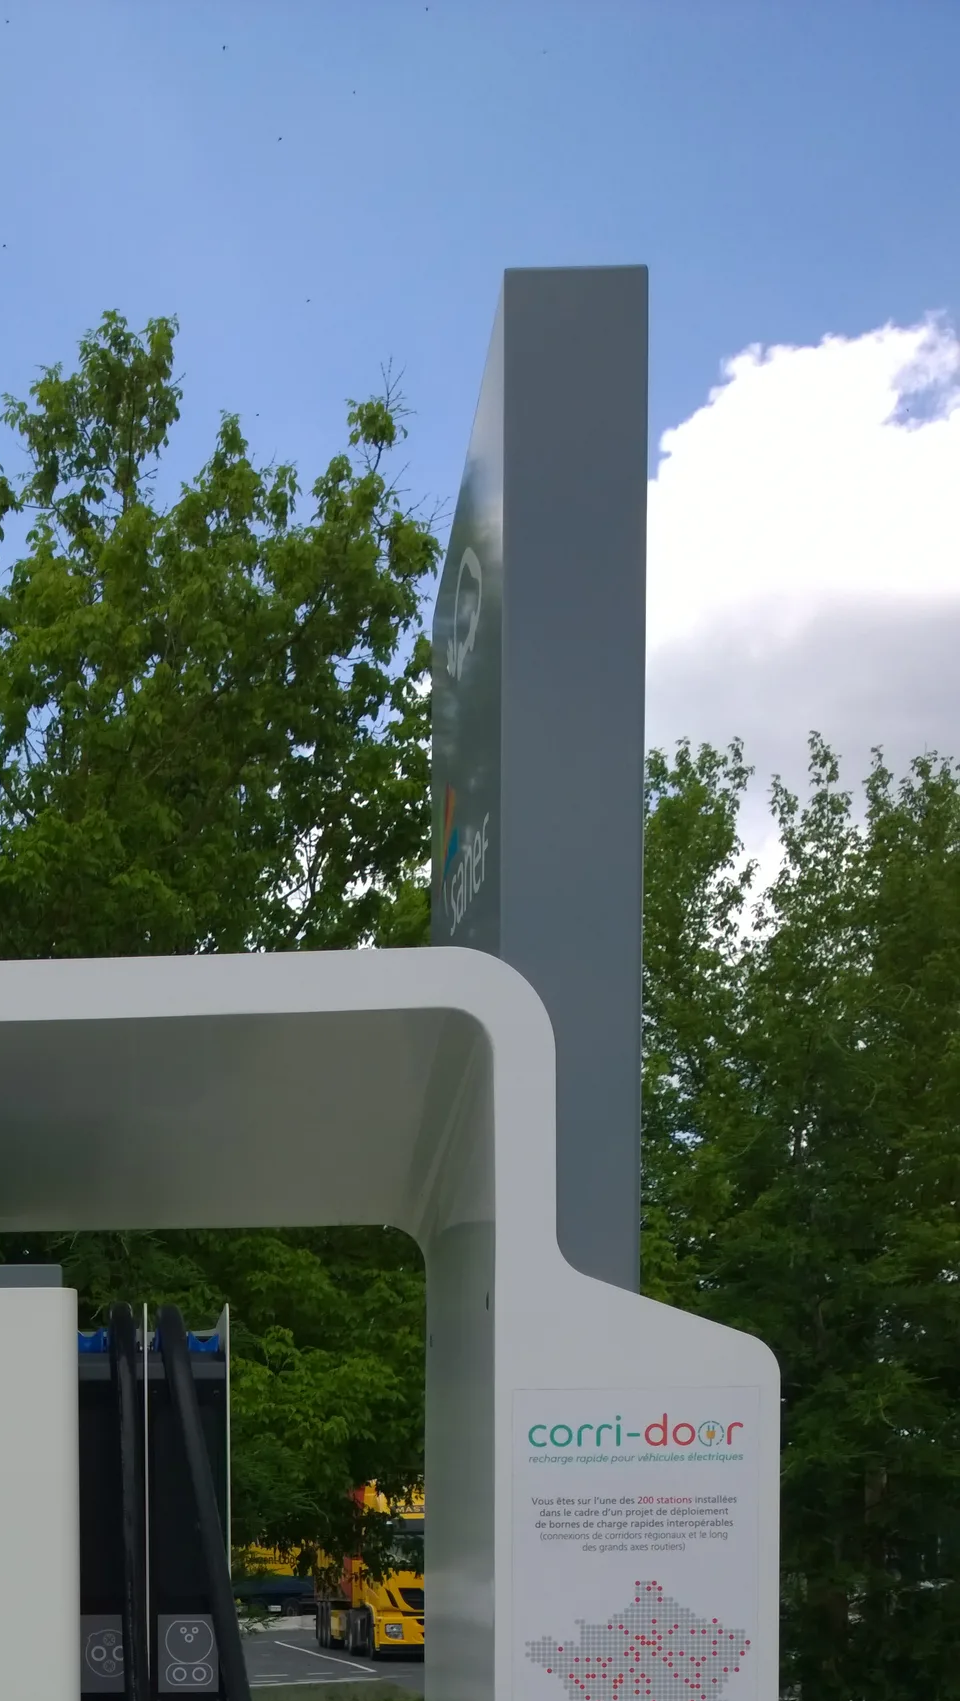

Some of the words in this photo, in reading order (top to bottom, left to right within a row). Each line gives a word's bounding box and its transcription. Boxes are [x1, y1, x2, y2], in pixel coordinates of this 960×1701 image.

[450, 812, 489, 936] sanef
[529, 1454, 573, 1465] recharge
[576, 1454, 609, 1464] rapide
[611, 1455, 635, 1464] pour
[638, 1453, 685, 1462] véhicules
[688, 1452, 744, 1462] électriques
[531, 1497, 554, 1505] Vous
[557, 1497, 575, 1505] êtes
[594, 1497, 617, 1505] l'une
[619, 1496, 635, 1505] des
[637, 1496, 654, 1504] 200
[656, 1496, 692, 1504] stations
[695, 1495, 737, 1503] installées
[539, 1508, 561, 1517] dans
[564, 1508, 571, 1516] le
[574, 1508, 599, 1516] cadre
[602, 1508, 622, 1516] d'un
[625, 1508, 653, 1517] projet
[655, 1507, 667, 1516] de
[670, 1507, 729, 1517] déploiement
[535, 1520, 546, 1528] de
[549, 1520, 580, 1528] bornes
[582, 1520, 594, 1528] de
[596, 1520, 628, 1530] charge
[630, 1519, 664, 1529] rapides
[666, 1518, 734, 1528] interopérables
[539, 1532, 589, 1541] (connexions
[605, 1531, 642, 1539] corridors
[644, 1531, 686, 1541] régionaux
[699, 1530, 707, 1538] le
[709, 1530, 728, 1540] long
[582, 1543, 597, 1551] des
[599, 1542, 627, 1553] grands
[650, 1542, 686, 1551] routiers)
